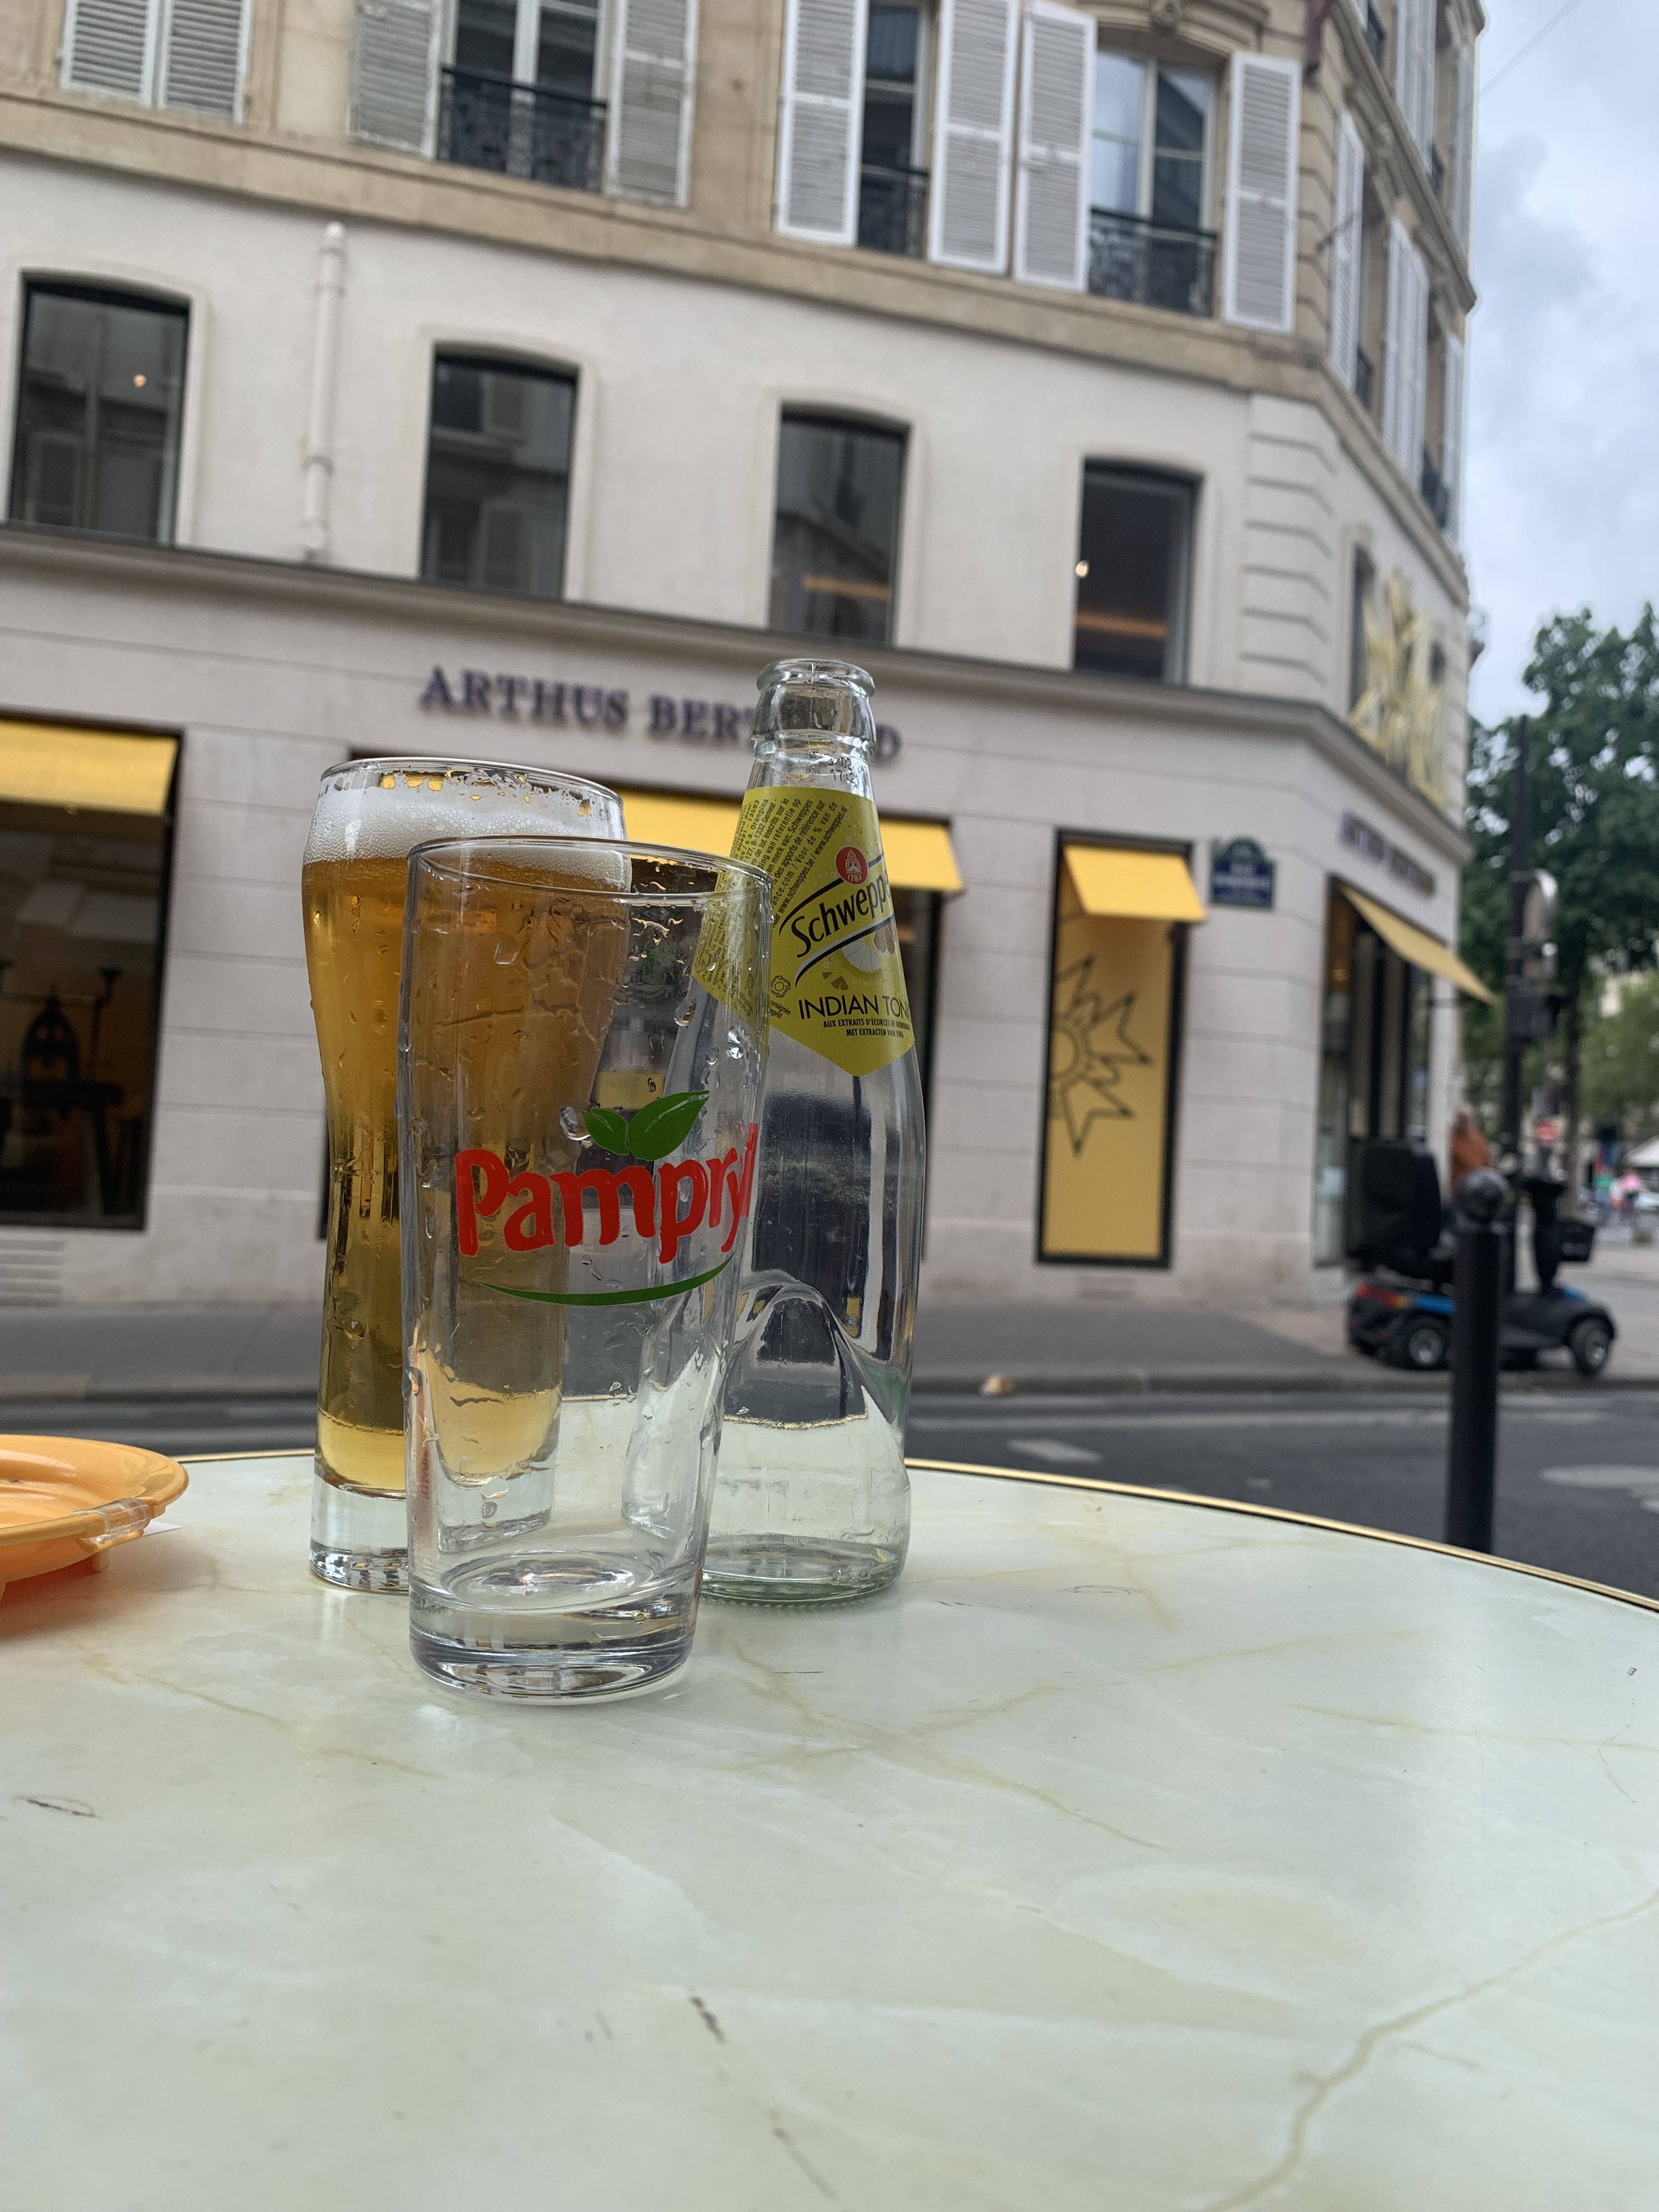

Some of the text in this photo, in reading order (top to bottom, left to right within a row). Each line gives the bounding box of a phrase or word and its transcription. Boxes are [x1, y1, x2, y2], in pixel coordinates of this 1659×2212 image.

[418, 663, 630, 728] ARTHUS
[748, 800, 760, 821] 13593
[751, 799, 769, 830] Orangina
[761, 802, 776, 823] Genval
[776, 805, 785, 816] sur
[757, 798, 802, 870] ding van referentie op
[763, 816, 779, 839] inscrits
[767, 799, 814, 874] en merk van: Schweppes
[775, 866, 785, 878] des
[781, 844, 798, 867] apports
[794, 836, 803, 845] de
[799, 809, 820, 838] référence
[815, 800, 826, 811] sur
[755, 849, 762, 857] de
[758, 839, 768, 848] lot
[772, 871, 795, 909] ance.com
[794, 847, 809, 863] Voor
[806, 836, 816, 845] de
[820, 812, 831, 825] van
[828, 802, 838, 811] de
[777, 859, 815, 913] www.schweppes.be
[814, 805, 848, 856] www.schweppes.nl
[847, 874, 862, 882] 1783
[798, 994, 879, 1019] INDIAN
[823, 1020, 837, 1028] AUX
[838, 1018, 865, 1026] EXTRAITS
[455, 1122, 758, 1264] Pampryl
